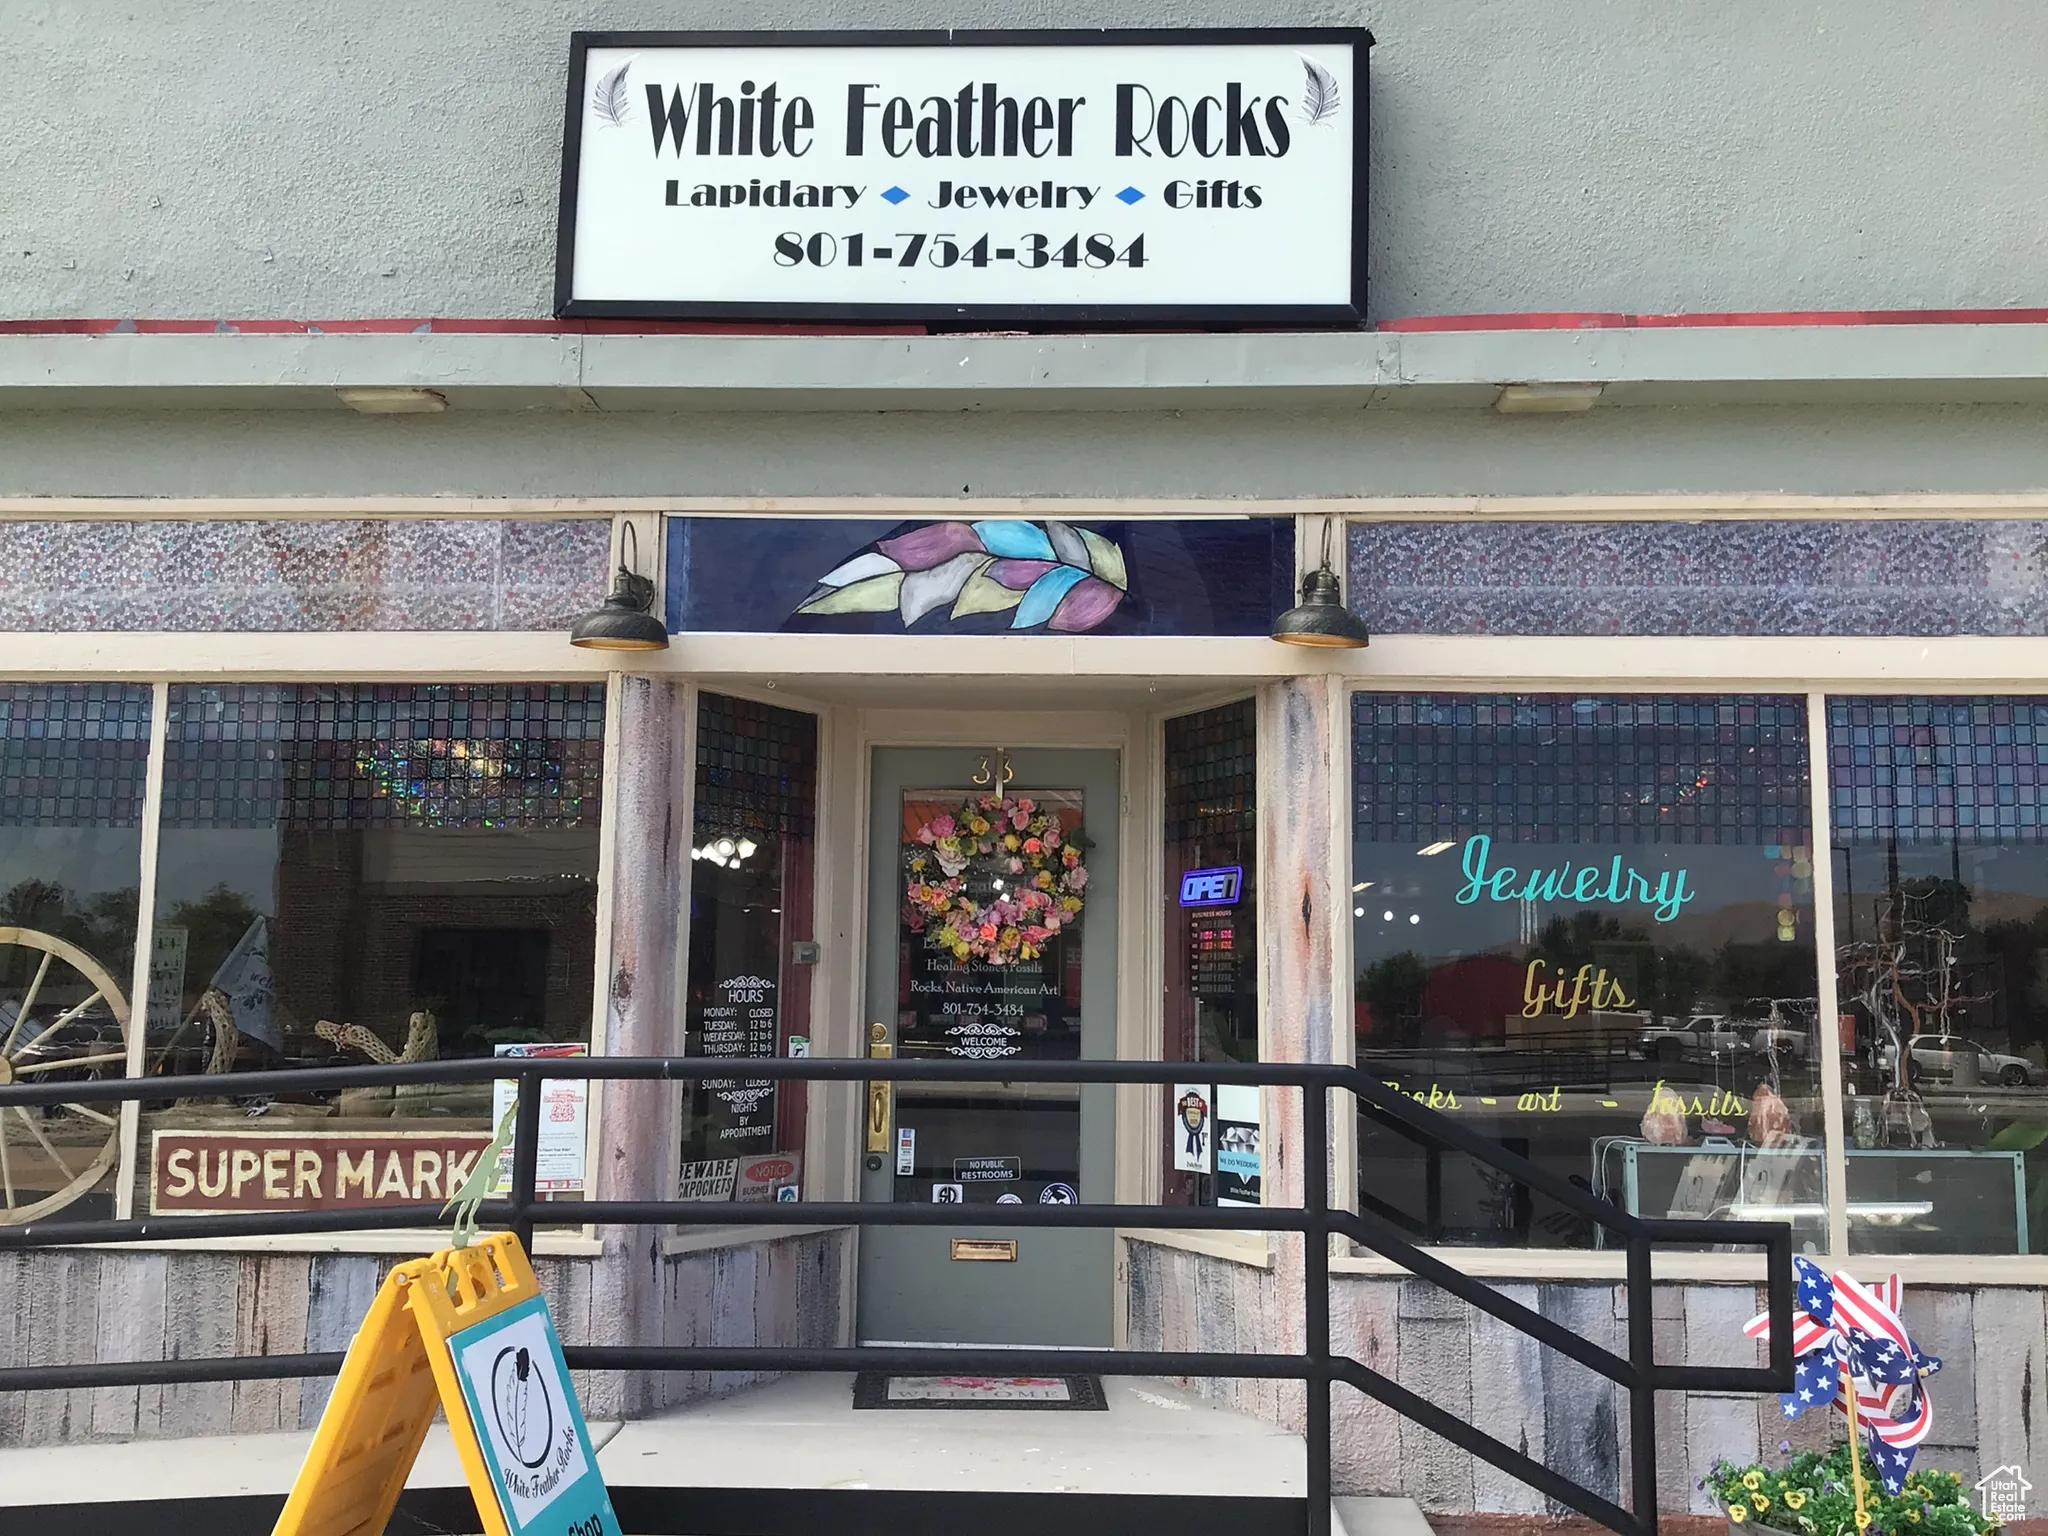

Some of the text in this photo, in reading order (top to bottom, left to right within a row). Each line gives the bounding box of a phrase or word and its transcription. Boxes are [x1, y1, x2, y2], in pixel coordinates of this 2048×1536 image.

[645, 80, 1292, 160] White Feather Rocks
[664, 178, 1263, 209] Lapidary Jewelry Gifts
[773, 231, 1150, 268] 801-754-3484
[1455, 834, 1695, 922] Jewelry
[926, 959, 970, 974] Healing
[910, 980, 1058, 996] Rocks, Native American Art
[1522, 958, 1635, 1020] Gifts
[728, 989, 764, 1004] HOURS
[703, 1007, 774, 1019] MONDAY: CLOSED
[942, 1002, 1025, 1017] 801-754-3484
[703, 1019, 773, 1032] TUESDAY: 12 to 6
[703, 1030, 773, 1043] WEDNESDAY: 12 to 6
[961, 1037, 1008, 1047] WELCOME
[703, 1042, 773, 1055] THURSDAY: 12 to 6
[701, 1079, 771, 1090] SUNDAY: CLOSED
[1516, 1086, 1562, 1112] art
[1649, 1080, 1749, 1117] fossils
[730, 1102, 758, 1114] NIGHTS
[739, 1115, 750, 1126] BY
[719, 1124, 772, 1140] APPOINTMENT
[755, 1164, 788, 1177] NOTICE
[969, 1160, 1004, 1169] NO PUBLIC
[165, 1148, 323, 1198] SUPER
[961, 1170, 1014, 1180] RESTROOMS
[899, 1390, 1059, 1398] WELCOME
[504, 1426, 574, 1499] White Feather Rocks
